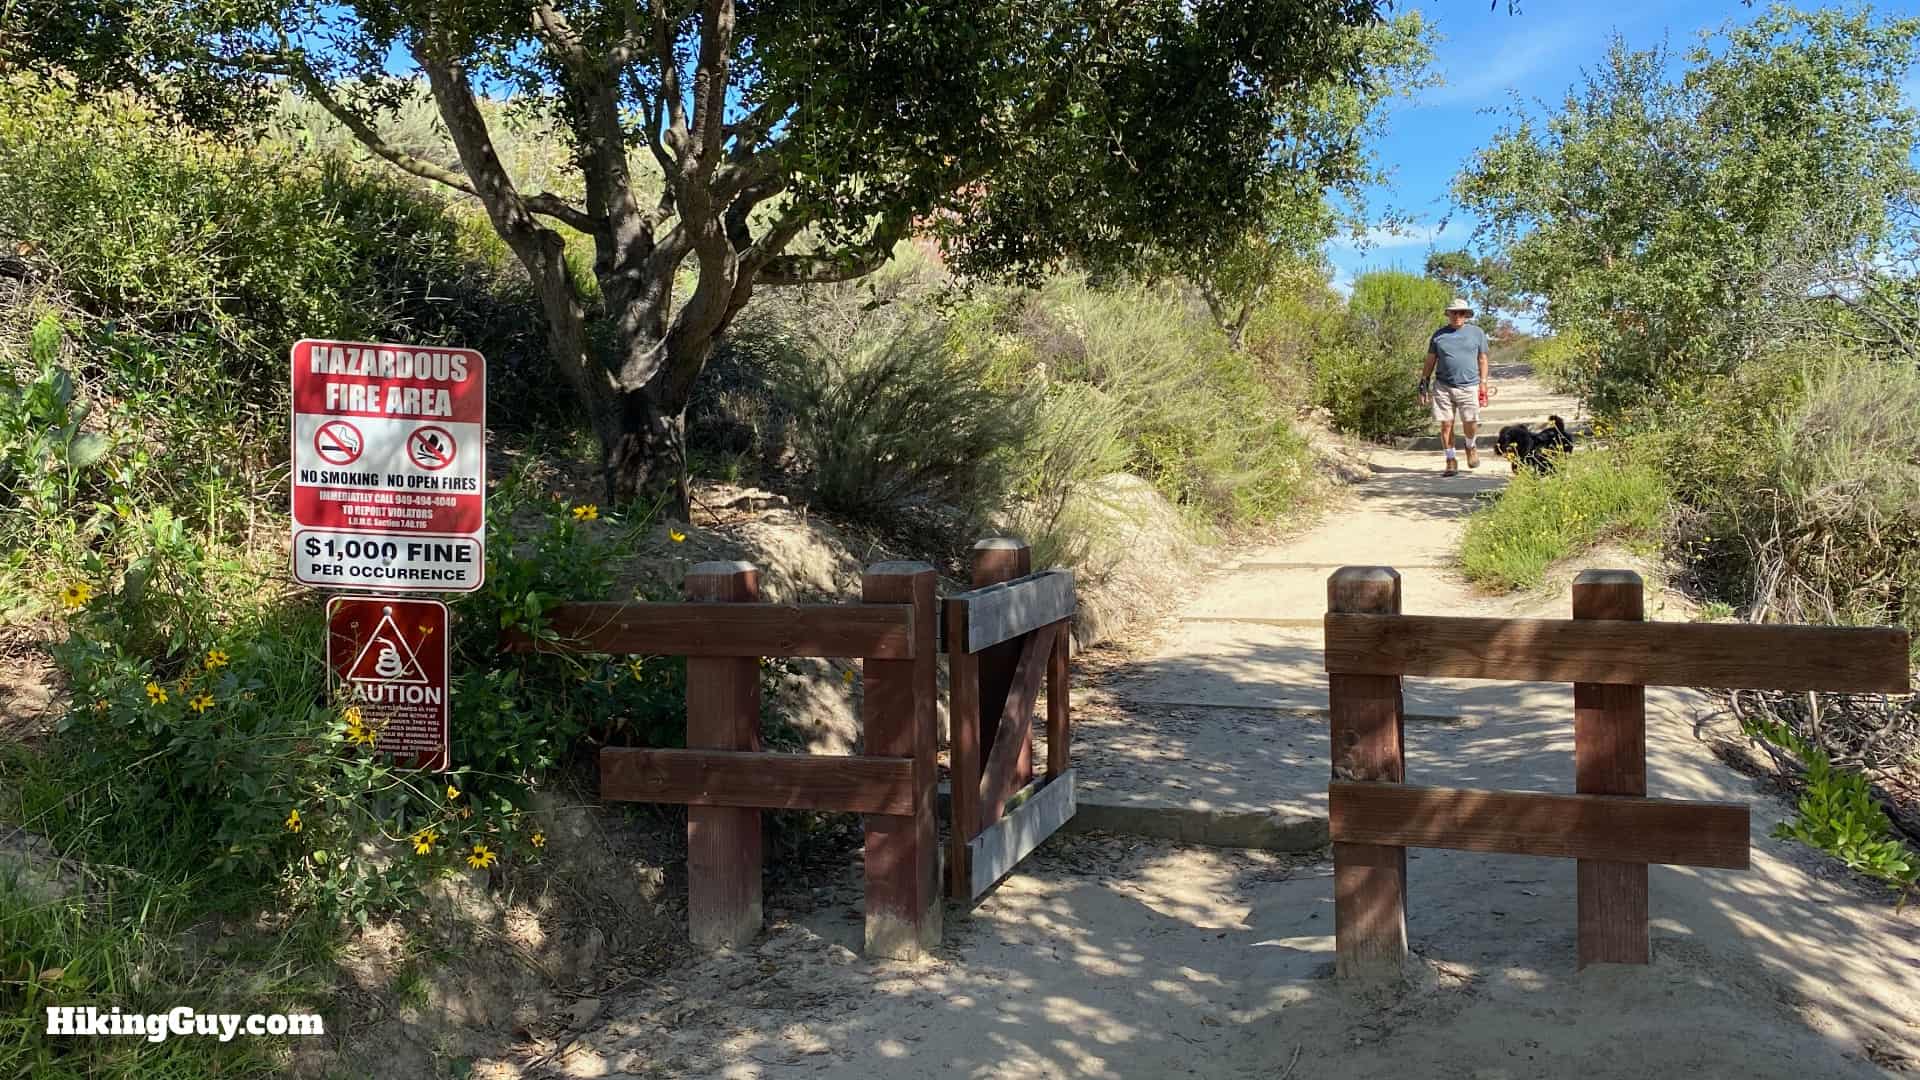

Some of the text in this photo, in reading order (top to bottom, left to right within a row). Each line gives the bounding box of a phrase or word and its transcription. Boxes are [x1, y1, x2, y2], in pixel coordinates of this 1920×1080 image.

[311, 346, 468, 382] HAZARDOUS
[326, 383, 452, 417] FIRE AREA
[301, 470, 379, 486] NO SMOKING
[387, 474, 476, 491] NO OPEN FIRES
[319, 490, 456, 507] IMMEDIATELY CALL 949-494-4040
[343, 505, 433, 519] TO REPORT VIOLATORS
[305, 536, 472, 563] $1,000 FINE
[311, 564, 466, 580] PER OCCURRENCE
